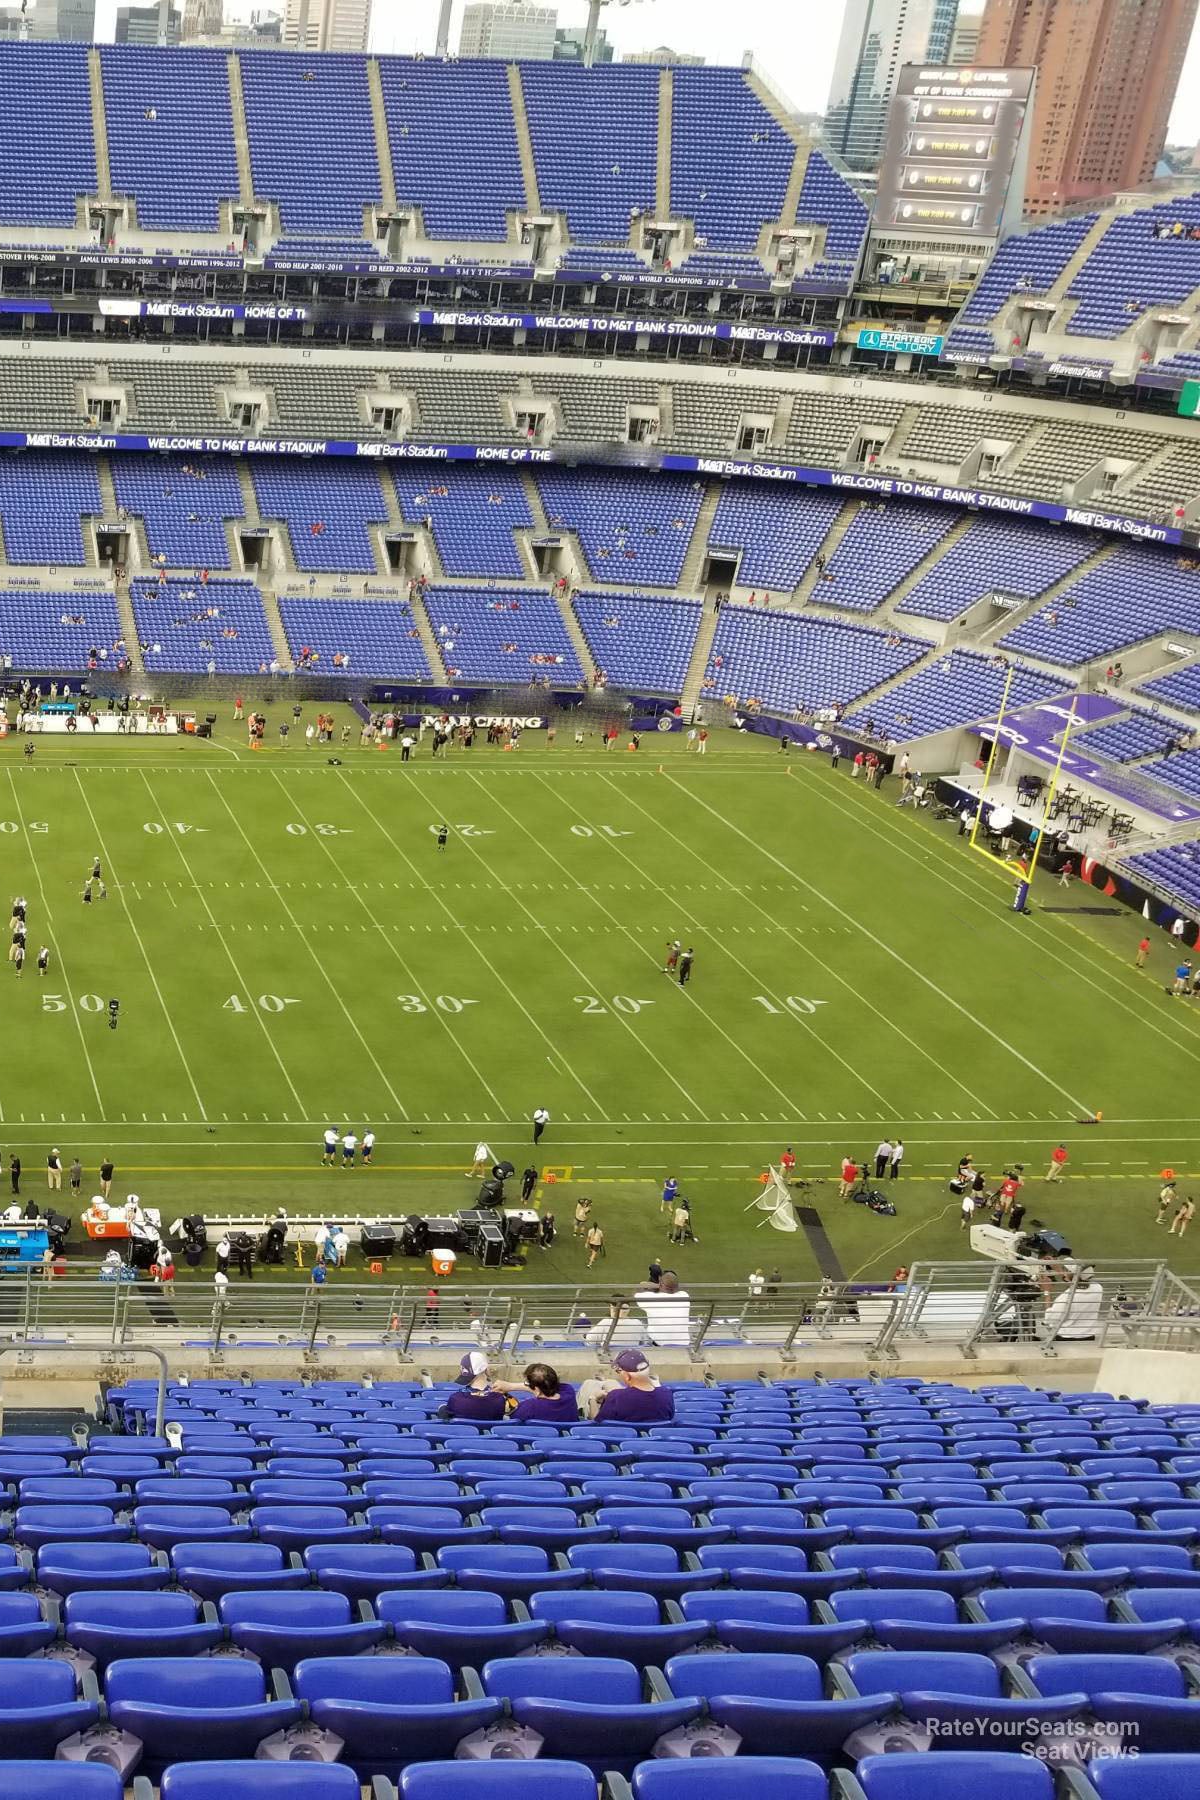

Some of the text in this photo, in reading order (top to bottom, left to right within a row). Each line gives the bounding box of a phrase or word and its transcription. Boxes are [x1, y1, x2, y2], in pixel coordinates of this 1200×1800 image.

[101, 256, 119, 264] LEWIS
[293, 262, 308, 270] HEAP
[310, 263, 343, 271] 2001-2010
[456, 268, 491, 276] SMYTH
[618, 274, 635, 282] 2000
[640, 275, 662, 283] WORLD
[665, 276, 702, 285] CHAMPIONS
[172, 304, 194, 316] Bank
[195, 305, 234, 317] Stadium
[244, 306, 275, 318] HOME
[277, 308, 293, 319] OF
[458, 314, 482, 325] Bank
[483, 314, 522, 327] Stadium
[535, 317, 716, 336] WELCOME TO M&T BANK STADIUM
[758, 328, 782, 340] Bank
[784, 330, 826, 345] Stadium
[880, 333, 936, 344] STRATEGIC
[879, 341, 935, 352] FACTORY
[945, 354, 987, 364] RAVENS
[1049, 362, 1102, 379] #RavensFlock
[52, 436, 76, 446] Bank
[77, 436, 116, 448] Stadium
[148, 438, 326, 453] WELCOME TO M&T BANK STADIUM
[383, 445, 407, 456] Bank
[408, 445, 447, 457] Stadium
[476, 448, 550, 461] HOME OF THE
[725, 462, 750, 475] Bank
[752, 464, 796, 479] Stadium
[831, 474, 1032, 512] WELCOME TO M&T BANK STADIUM
[1094, 514, 1122, 530] Bank
[1122, 520, 1166, 541] Stadium
[42, 995, 104, 1013] 50
[222, 995, 286, 1013] 40
[397, 995, 464, 1013] 30
[573, 995, 642, 1013] 20
[752, 996, 816, 1014] 10
